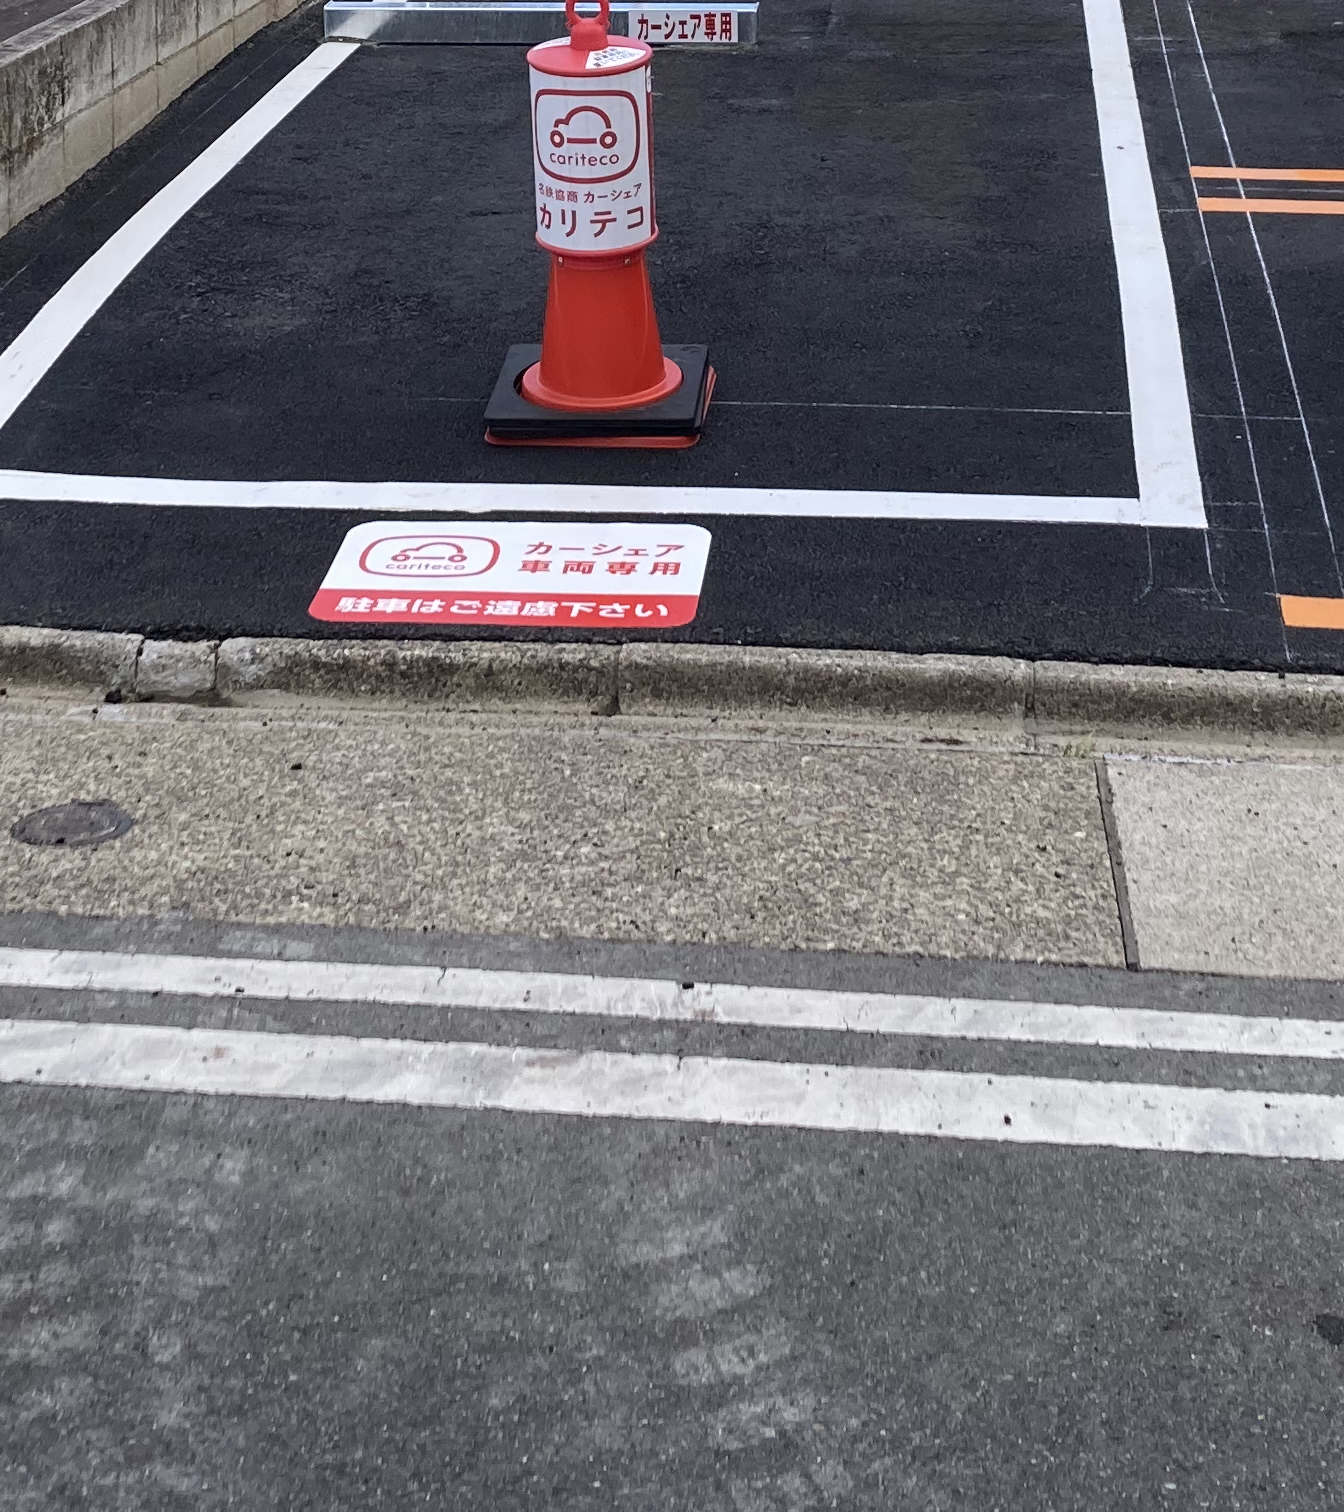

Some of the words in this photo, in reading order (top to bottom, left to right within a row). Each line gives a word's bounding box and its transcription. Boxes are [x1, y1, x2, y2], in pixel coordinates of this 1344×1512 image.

[637, 11, 733, 42] カーシェア専用
[549, 152, 620, 167] cariteco
[583, 182, 642, 203] カーシェア
[539, 202, 645, 238] カリテコ
[524, 541, 686, 558] カーシェア
[384, 562, 466, 572] cariteco
[517, 559, 682, 577] 車両専用
[333, 596, 669, 619] 駐車はご遠慮下さい
